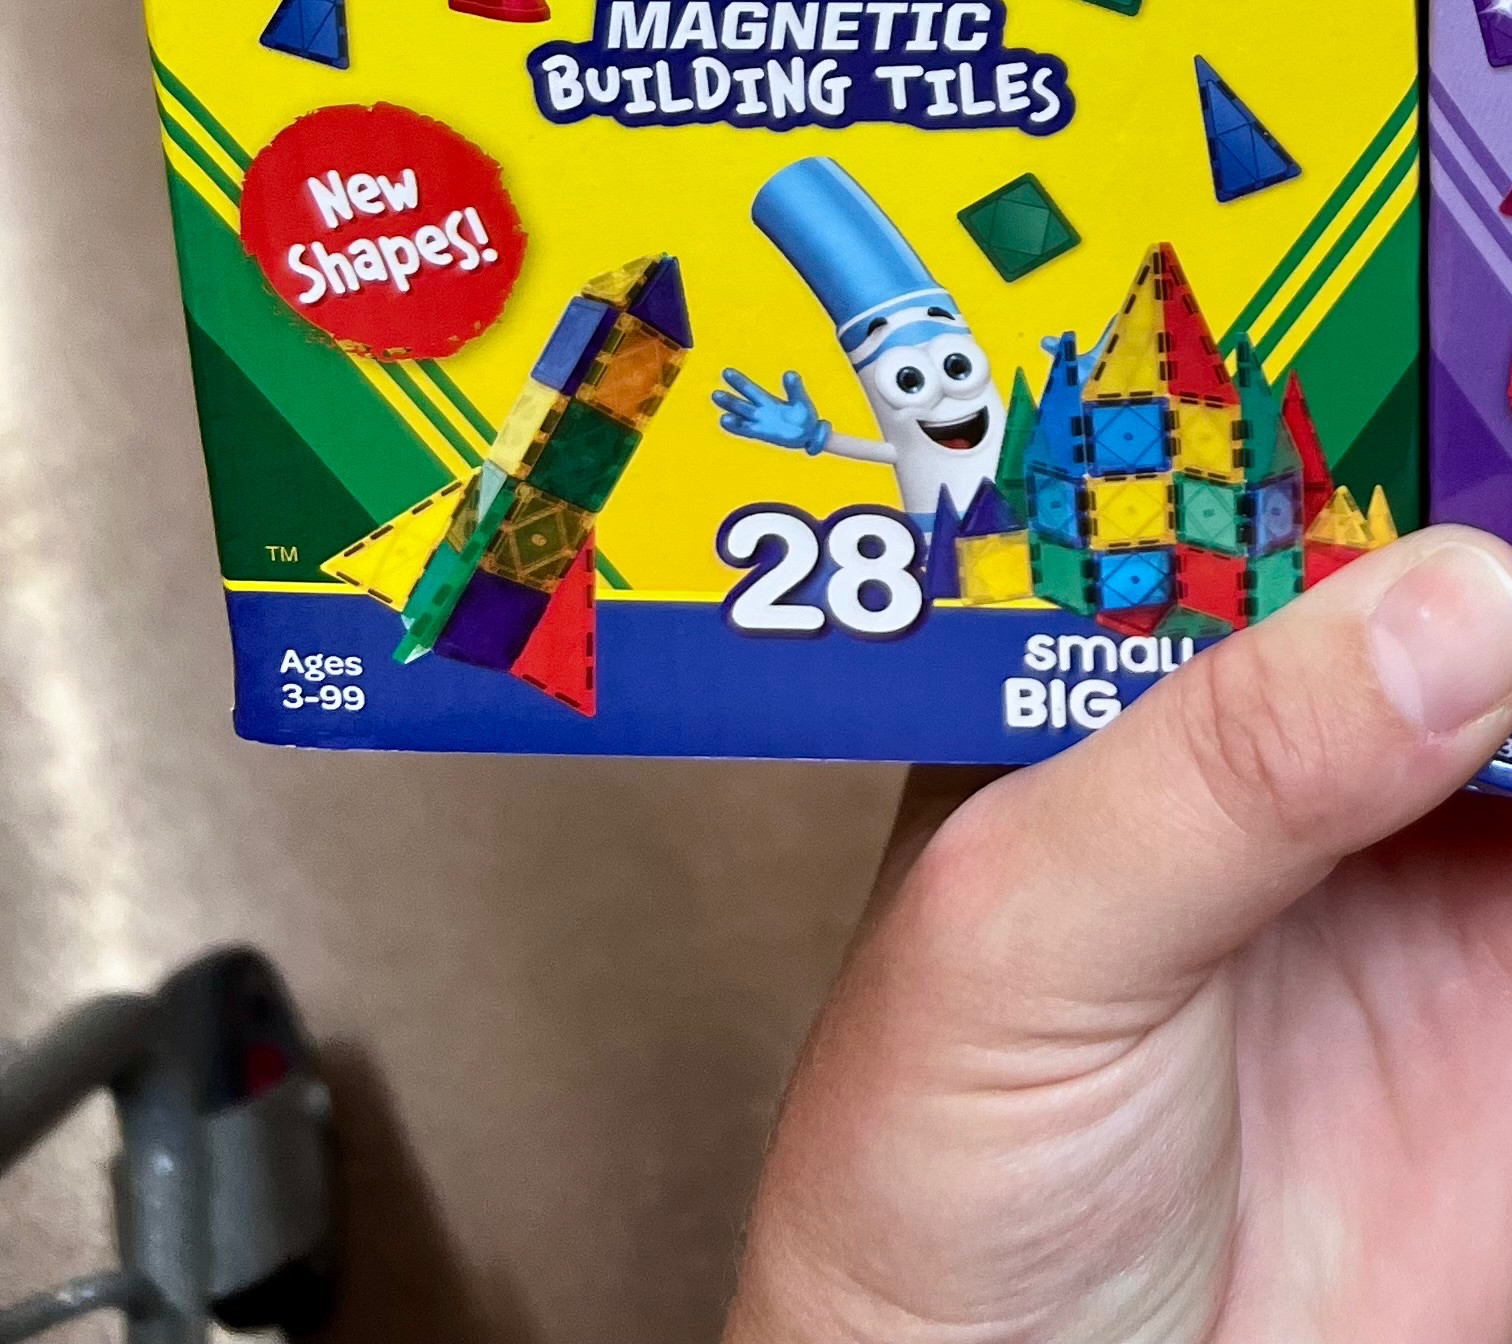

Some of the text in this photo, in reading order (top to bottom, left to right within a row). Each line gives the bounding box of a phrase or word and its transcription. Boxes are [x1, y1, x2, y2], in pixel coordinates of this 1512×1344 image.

[606, 1, 991, 51] MAGNETIC
[541, 55, 1060, 122] BUILDING TILES
[306, 168, 419, 230] New
[287, 207, 498, 306] Shapes!
[725, 512, 923, 634] 28
[280, 648, 363, 678] Ages
[281, 683, 366, 711] 3-99
[1004, 678, 1121, 728] BIG
